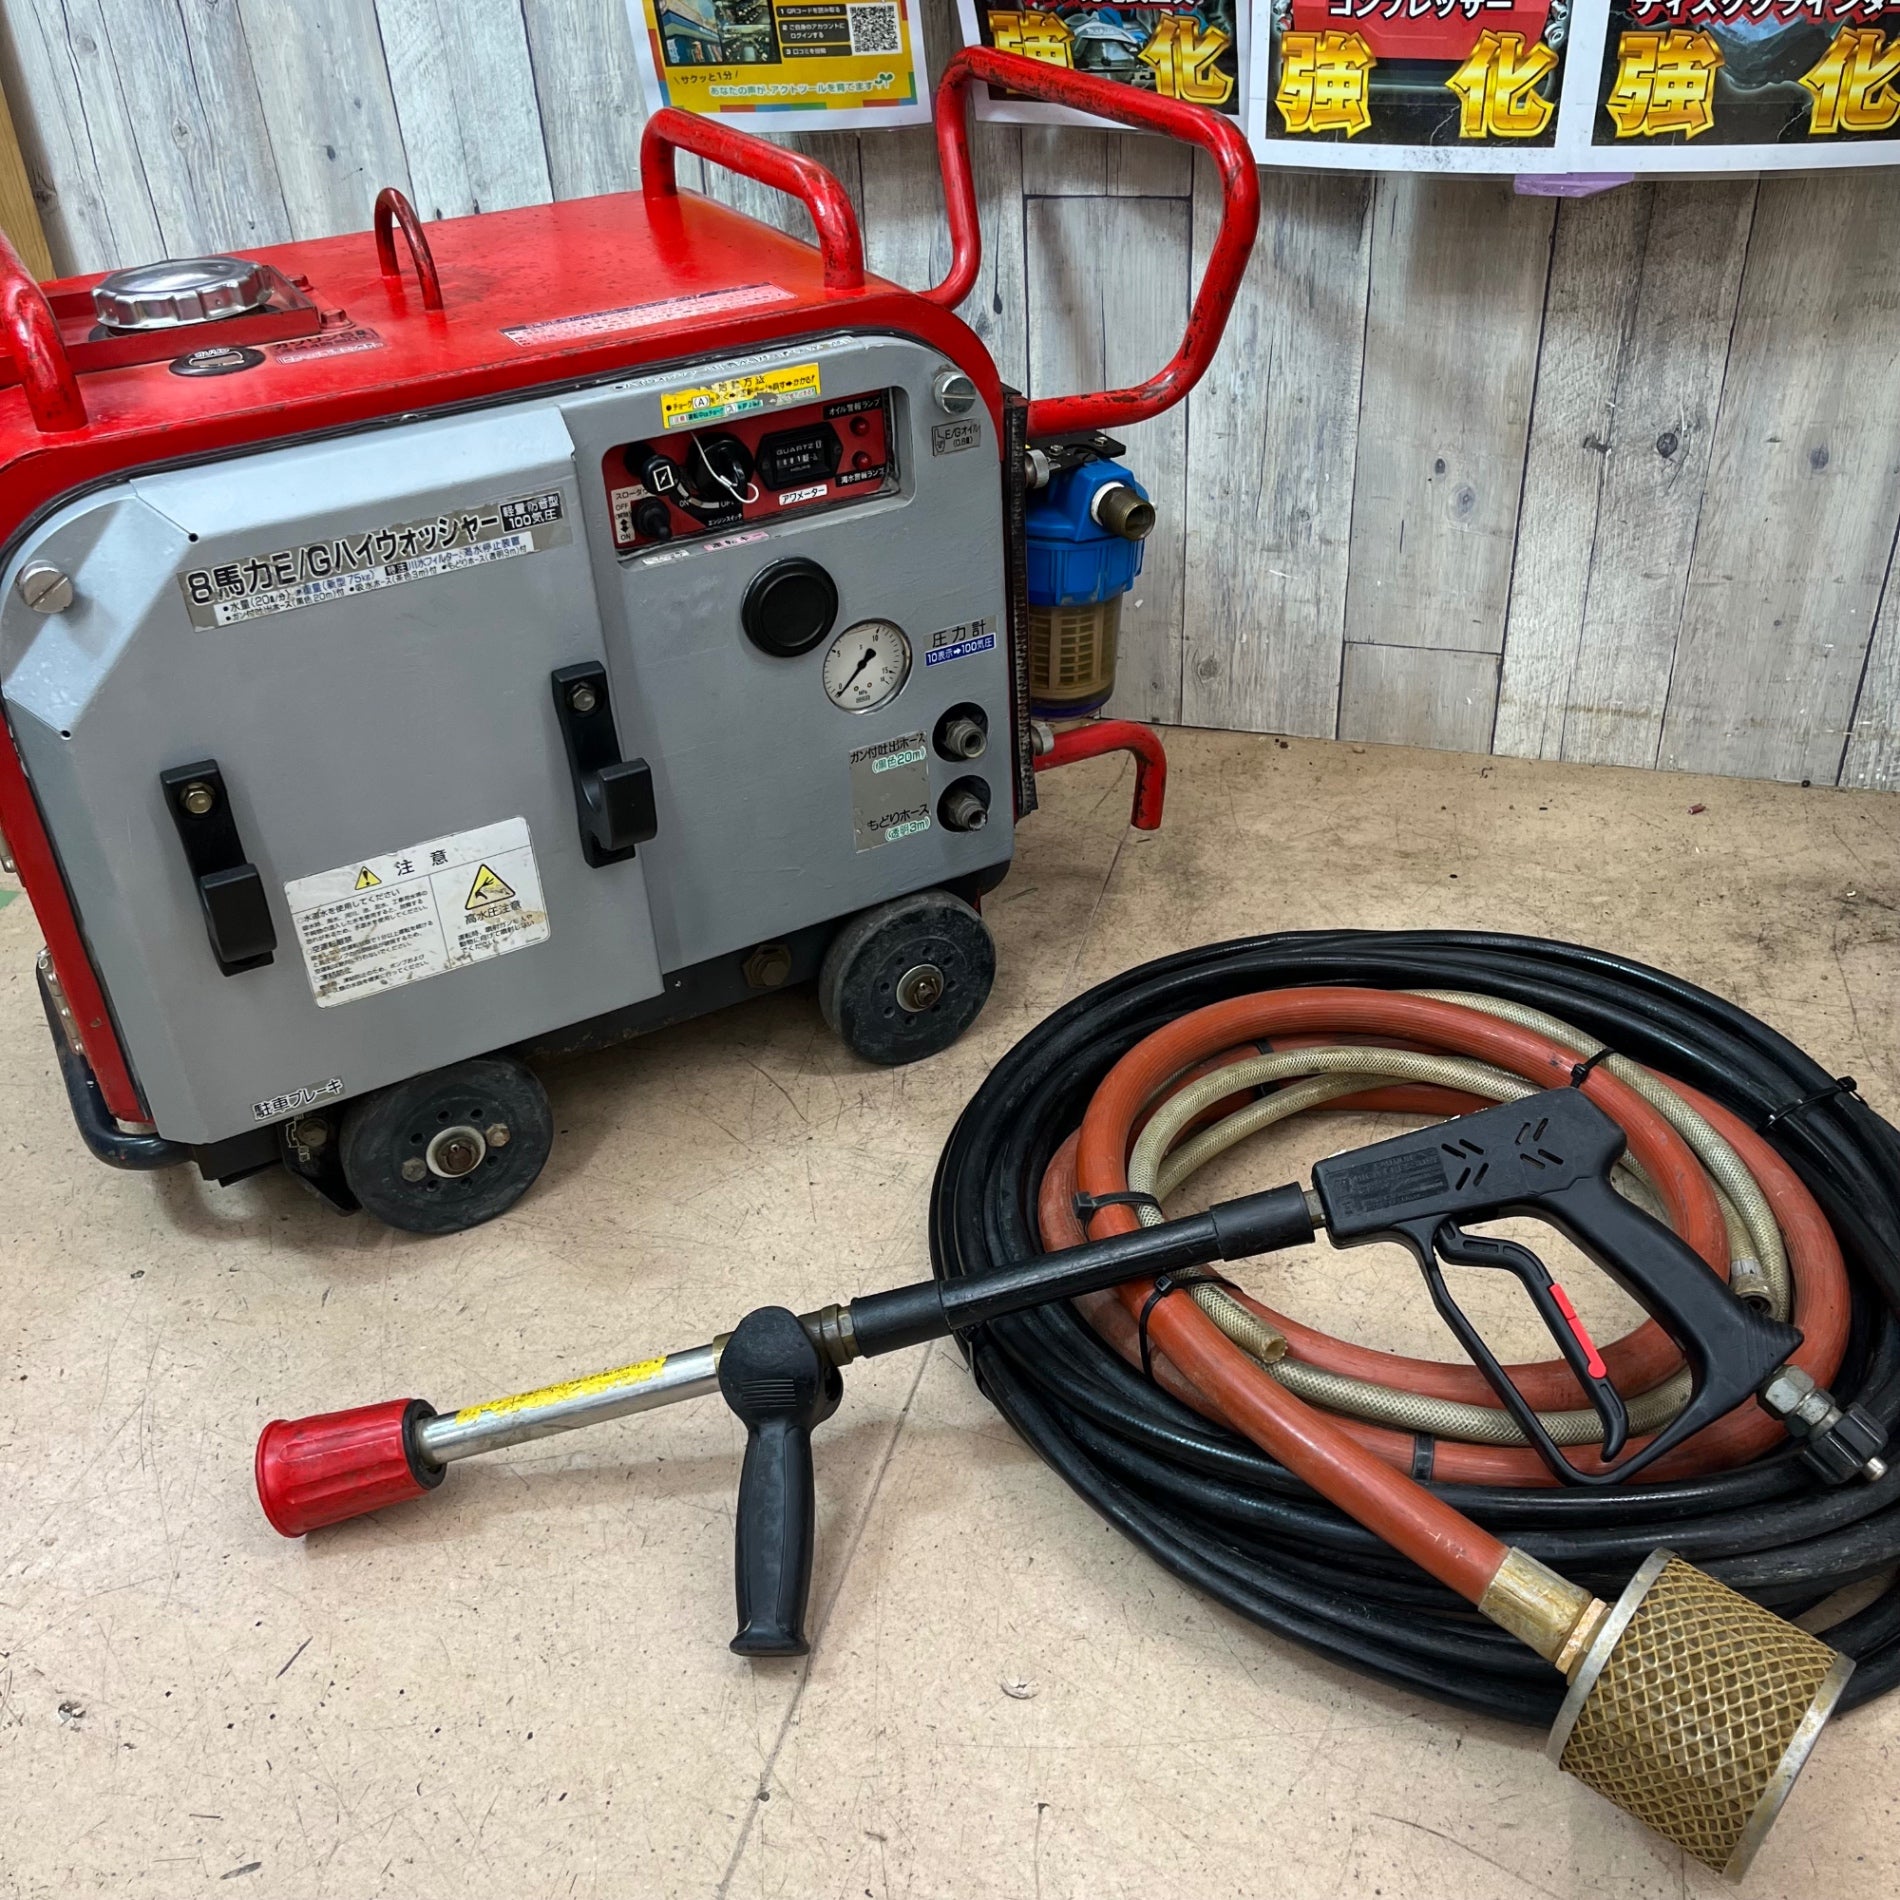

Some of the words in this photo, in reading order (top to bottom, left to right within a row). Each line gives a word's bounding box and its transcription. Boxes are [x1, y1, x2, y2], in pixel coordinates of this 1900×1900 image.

[781, 487, 827, 505] アワメーター
[508, 506, 558, 530] 100気圧
[620, 533, 632, 542] ON
[932, 619, 986, 648] 圧力計
[850, 732, 926, 764] ガン付吐出ホース
[868, 803, 930, 831] もどりホース
[395, 849, 449, 877] 注意
